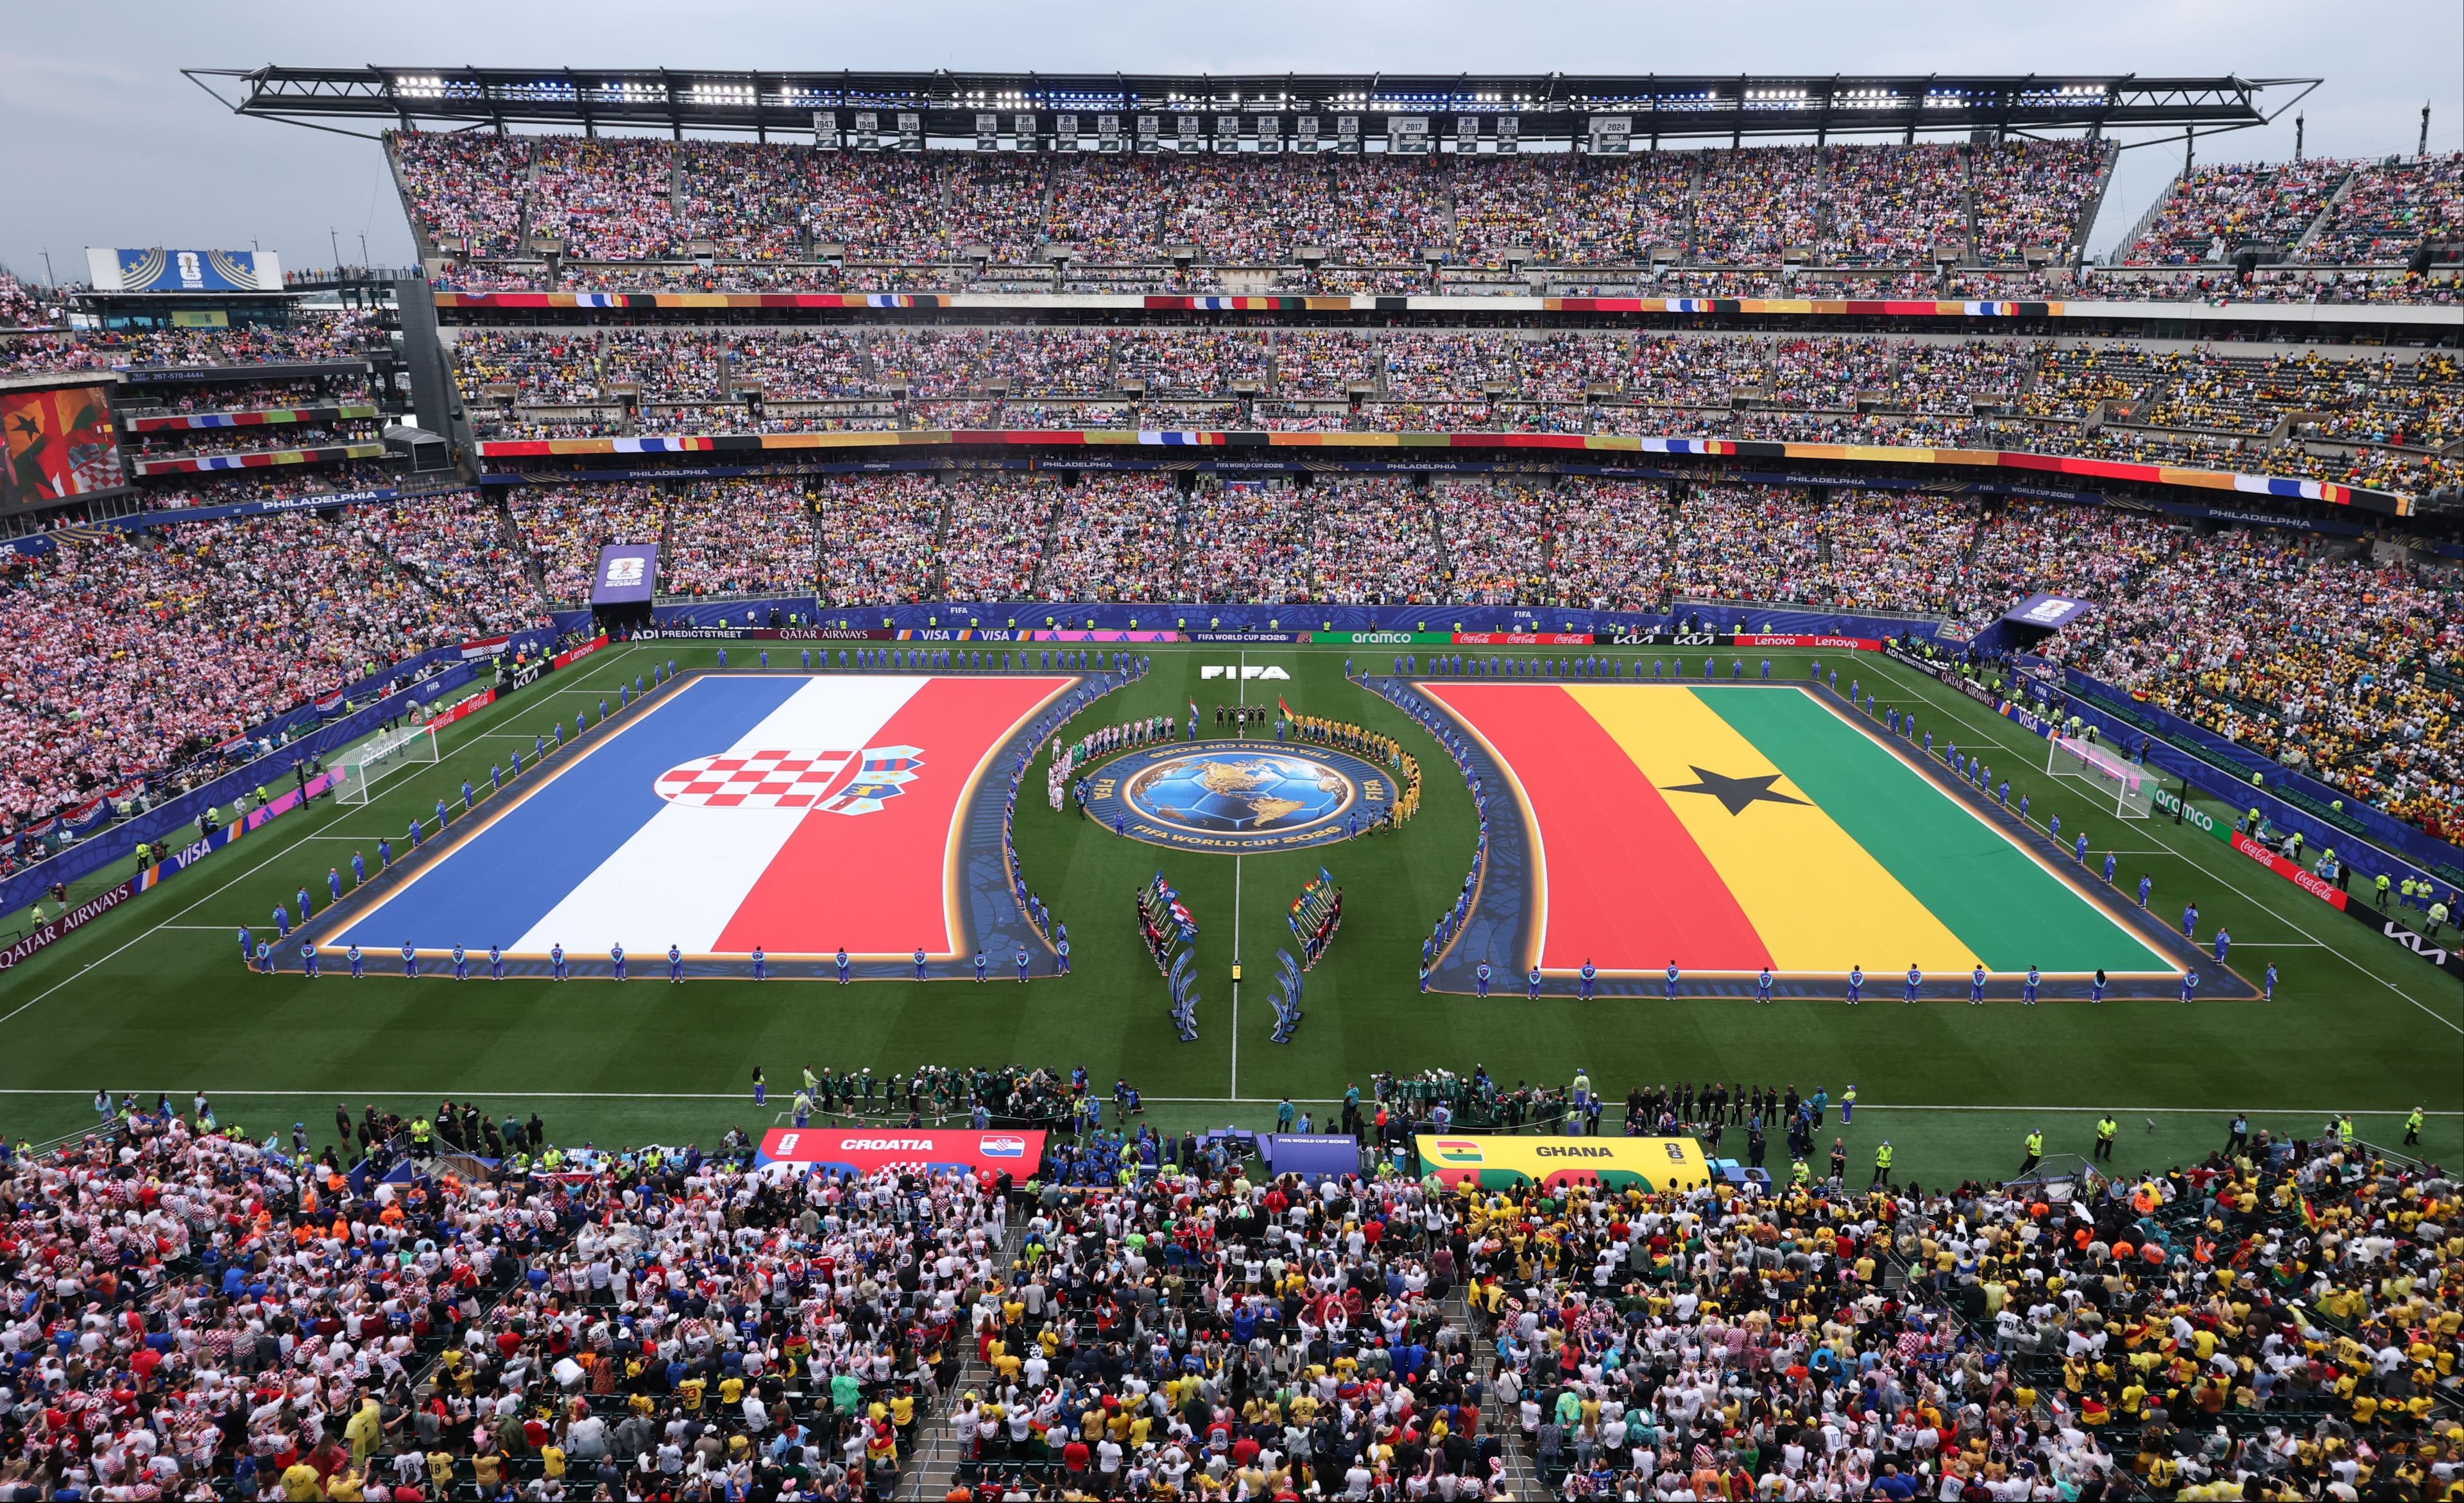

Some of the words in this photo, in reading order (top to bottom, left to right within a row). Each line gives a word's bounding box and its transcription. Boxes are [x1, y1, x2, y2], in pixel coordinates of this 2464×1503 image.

[153, 371, 205, 380] 267-570-4444
[1786, 476, 1866, 485] PHILADELPHIA
[262, 491, 377, 510] PHILADELPHIA
[2050, 491, 2075, 499] 2026
[2209, 509, 2311, 527] PHILADELPHIA
[631, 630, 659, 640] ADI
[662, 630, 742, 638] PREDICTSTREET
[780, 630, 817, 640] QATAR
[822, 630, 868, 639] AIRWAYS
[919, 630, 950, 640] VISA
[979, 630, 1009, 640] VISA
[1352, 633, 1411, 643] aramco
[1754, 636, 1796, 645] Lenovo
[1815, 636, 1858, 649] Lenovo
[468, 652, 506, 663] HAMILTON
[570, 645, 594, 661] Lenovo
[1886, 647, 1899, 659] ADI
[1899, 653, 1937, 676] PREDICTSTREET
[1201, 666, 1290, 680] FIFA
[427, 681, 440, 693] FIFA
[1941, 672, 1964, 692] QATAR
[1965, 686, 1995, 707] AIRWAYS
[2035, 685, 2047, 698] FIFA
[2017, 710, 2038, 733] VISA
[1149, 745, 1203, 759] 2026
[1239, 743, 1295, 752] WORLD
[1299, 749, 1331, 760] FIFA
[1093, 778, 1116, 801] FIFA
[1362, 779, 1384, 801] FIFA
[2155, 789, 2213, 831] aramco
[1132, 824, 1168, 839] FIFA
[1172, 833, 1246, 847] WORLD
[1247, 838, 1279, 847] CUP
[1282, 824, 1344, 844] 2026
[173, 838, 212, 869] VISA
[64, 883, 129, 934] AIRWAYS
[840, 1139, 934, 1150] CROATIA
[1536, 1146, 1614, 1157] GHANA
[878, 1193, 886, 1202] 10
[425, 1259, 431, 1268] 2
[406, 1271, 415, 1281] 10
[776, 1282, 785, 1291] 10
[1072, 1278, 1080, 1288] 10
[2005, 1320, 2014, 1330] 10
[594, 1329, 605, 1340] 22
[743, 1330, 751, 1339] 10
[2341, 1344, 2353, 1357] 10
[88, 1382, 94, 1393] 5
[1302, 1406, 1307, 1414] 5
[964, 1425, 973, 1434] 21
[1215, 1434, 1223, 1443] 10
[1831, 1434, 1840, 1447] 10
[402, 1462, 415, 1474] 18
[429, 1463, 440, 1475] 18
